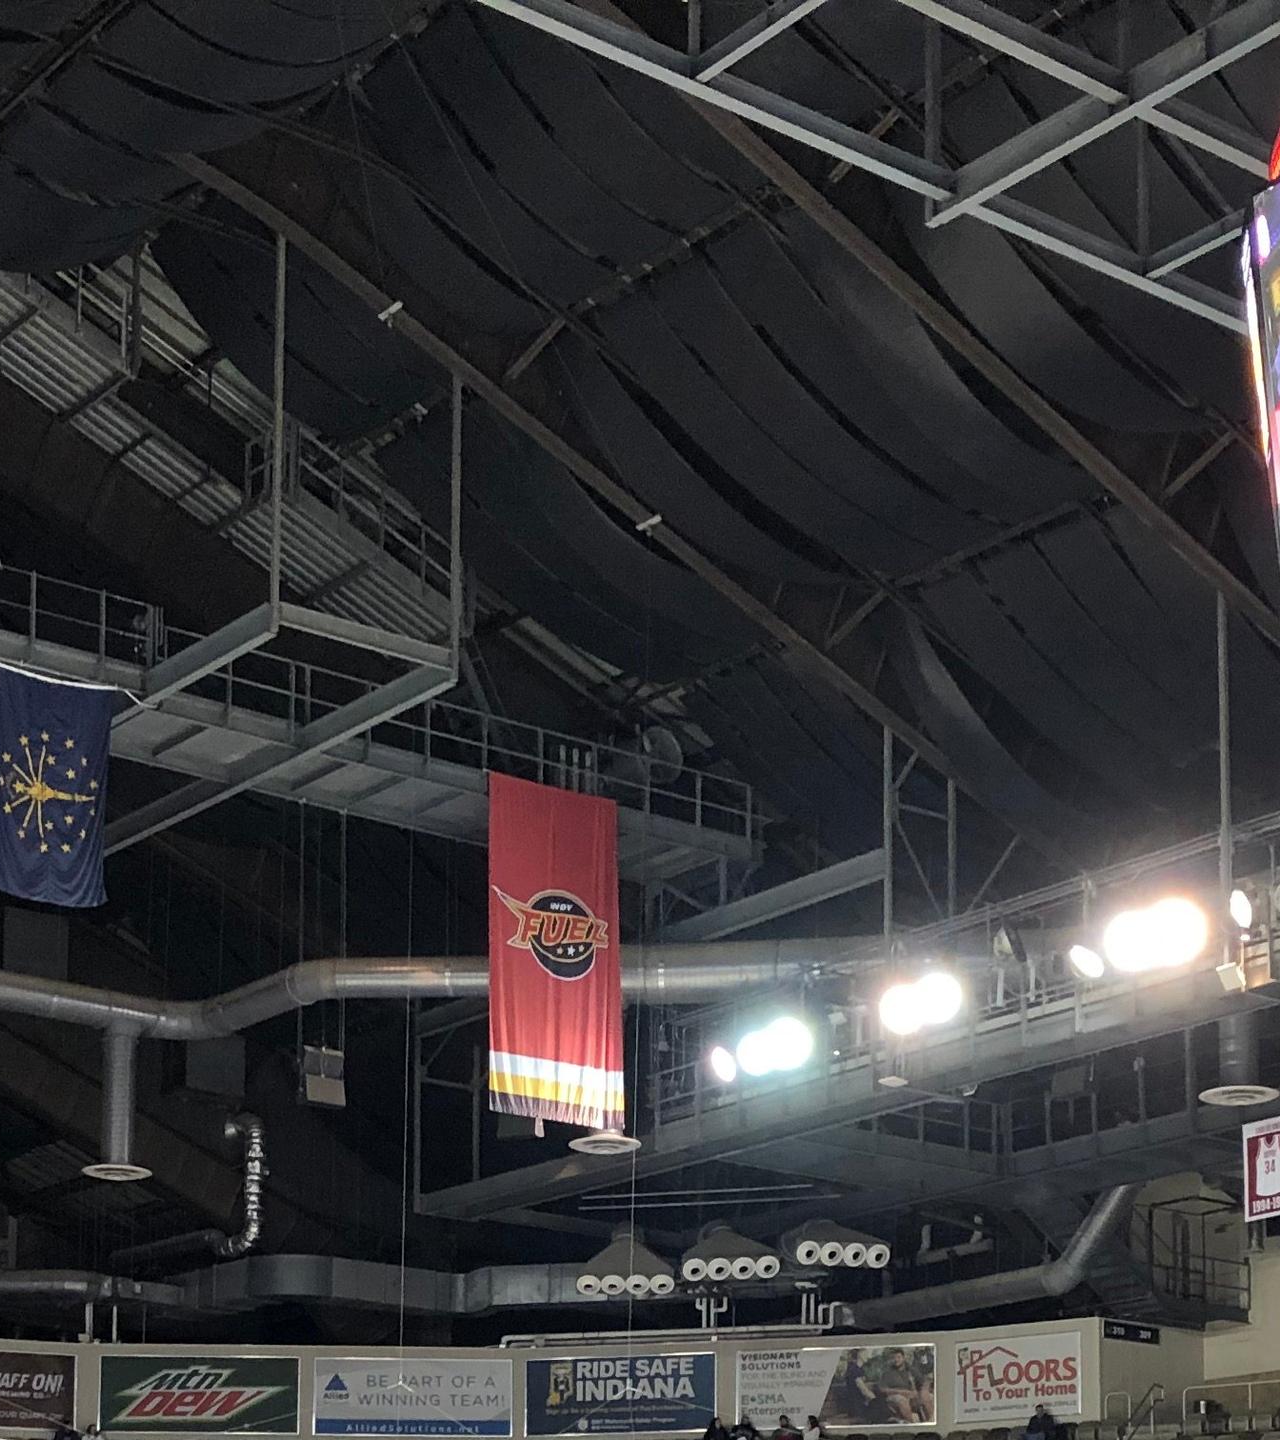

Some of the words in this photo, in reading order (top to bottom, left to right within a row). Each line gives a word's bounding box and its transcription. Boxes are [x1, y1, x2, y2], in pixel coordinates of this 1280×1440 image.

[550, 901, 574, 912] INDY
[506, 907, 610, 950] FUEL
[1264, 1158, 1276, 1175] 34
[740, 1351, 800, 1362] VISIONARY
[576, 1359, 630, 1380] RIDE
[634, 1357, 695, 1377] SAFE
[740, 1361, 802, 1372] SOLUTIONS
[972, 1356, 1078, 1388] FLOORS
[31, 1373, 65, 1397] ON!
[366, 1374, 391, 1388] BE
[400, 1374, 444, 1389] PART
[451, 1374, 479, 1389] OF
[483, 1374, 497, 1388] A
[576, 1376, 696, 1402] INDIANA
[323, 1390, 350, 1400] Allied
[356, 1392, 442, 1408] WINNING
[448, 1393, 506, 1409] TEAM!
[972, 1388, 992, 1402] To
[996, 1386, 1030, 1401] Your
[1033, 1382, 1077, 1397] Home
